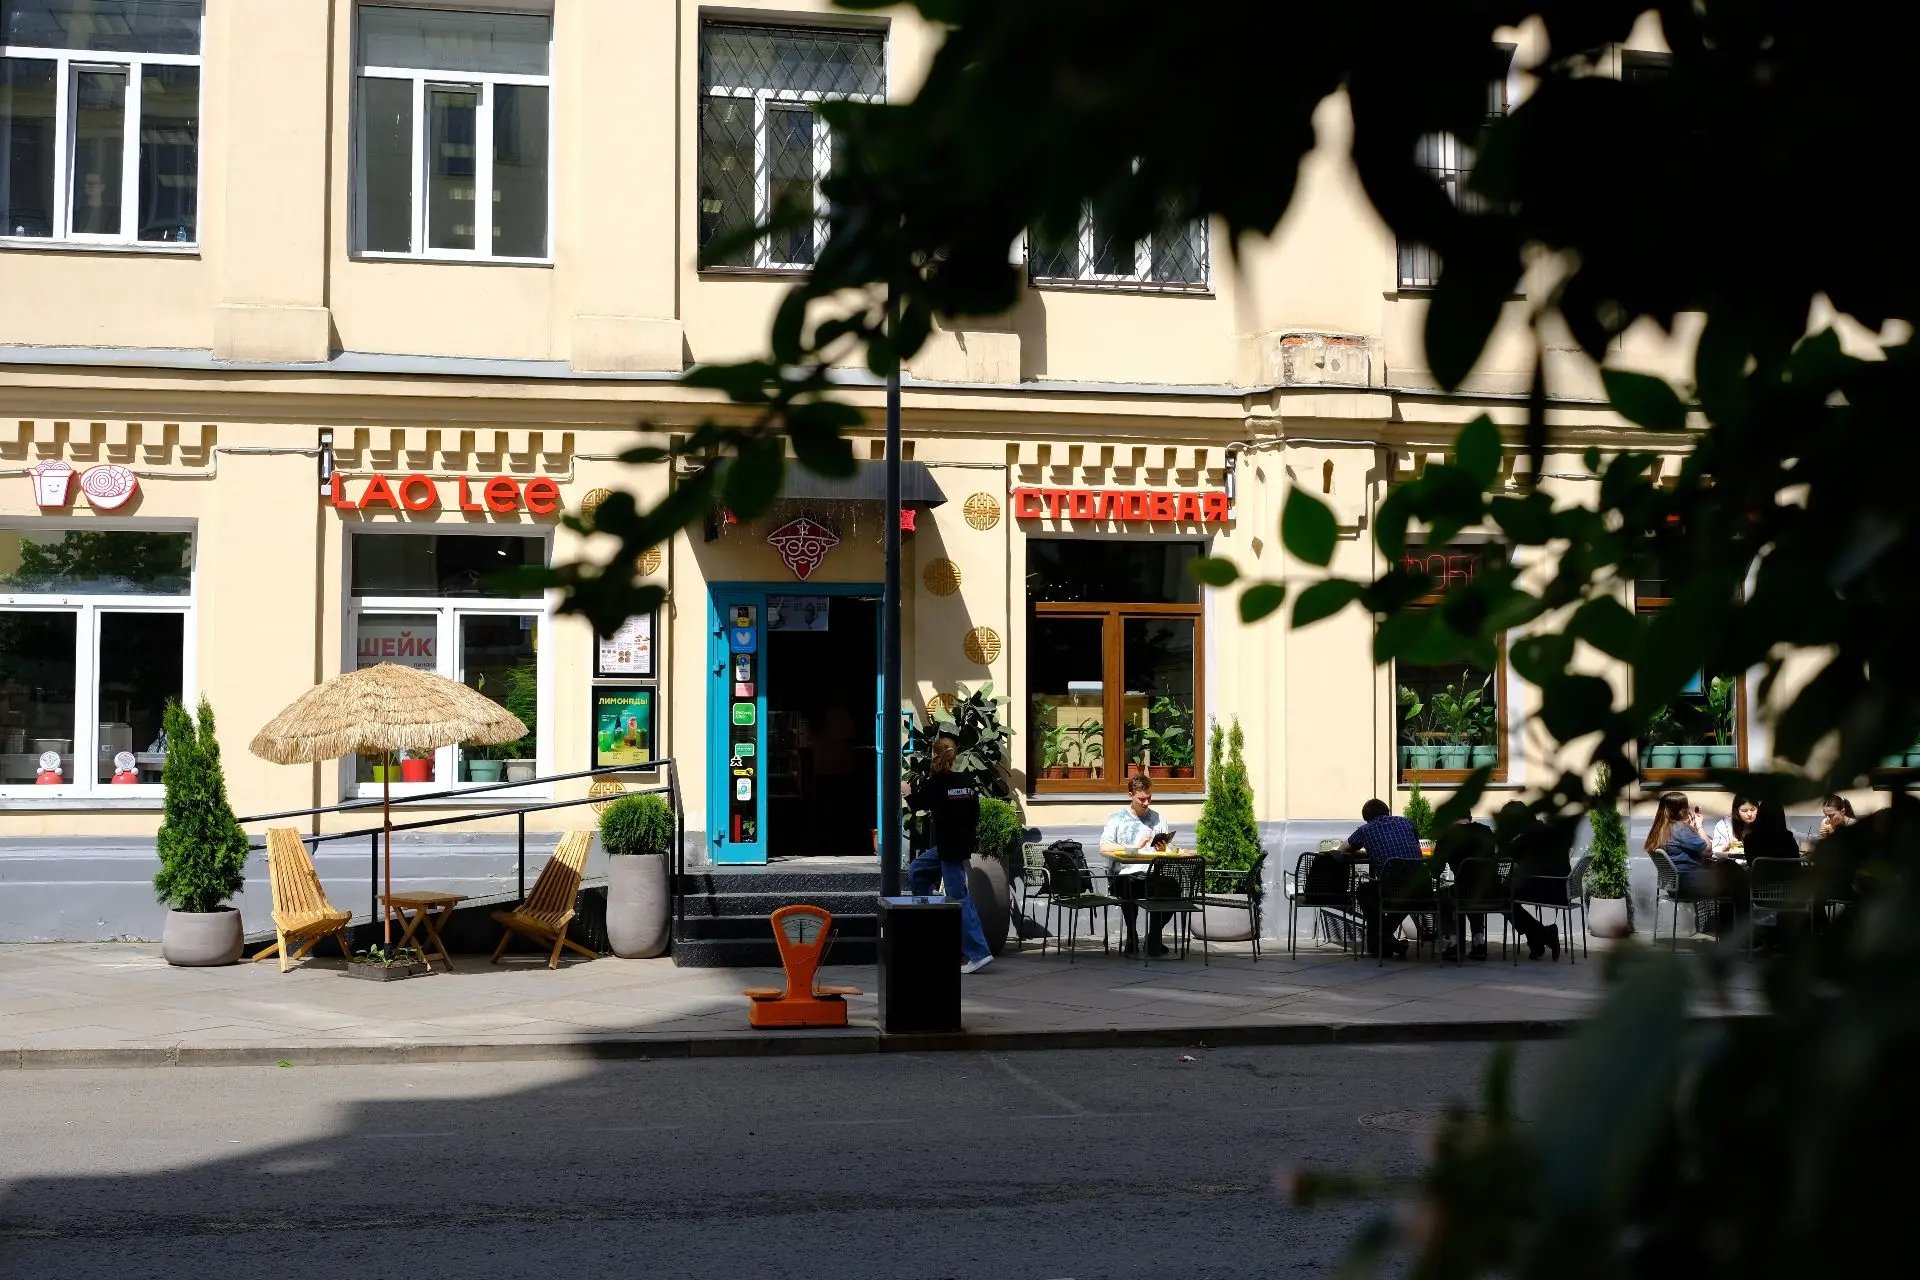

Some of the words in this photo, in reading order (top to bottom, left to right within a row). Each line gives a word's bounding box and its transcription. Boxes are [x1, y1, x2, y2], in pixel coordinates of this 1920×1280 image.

[331, 474, 437, 510] LAO
[459, 475, 559, 514] Lee
[1015, 490, 1229, 522] СТОЛОВАЯ
[598, 697, 648, 705] ЛИМОНАДЫ
